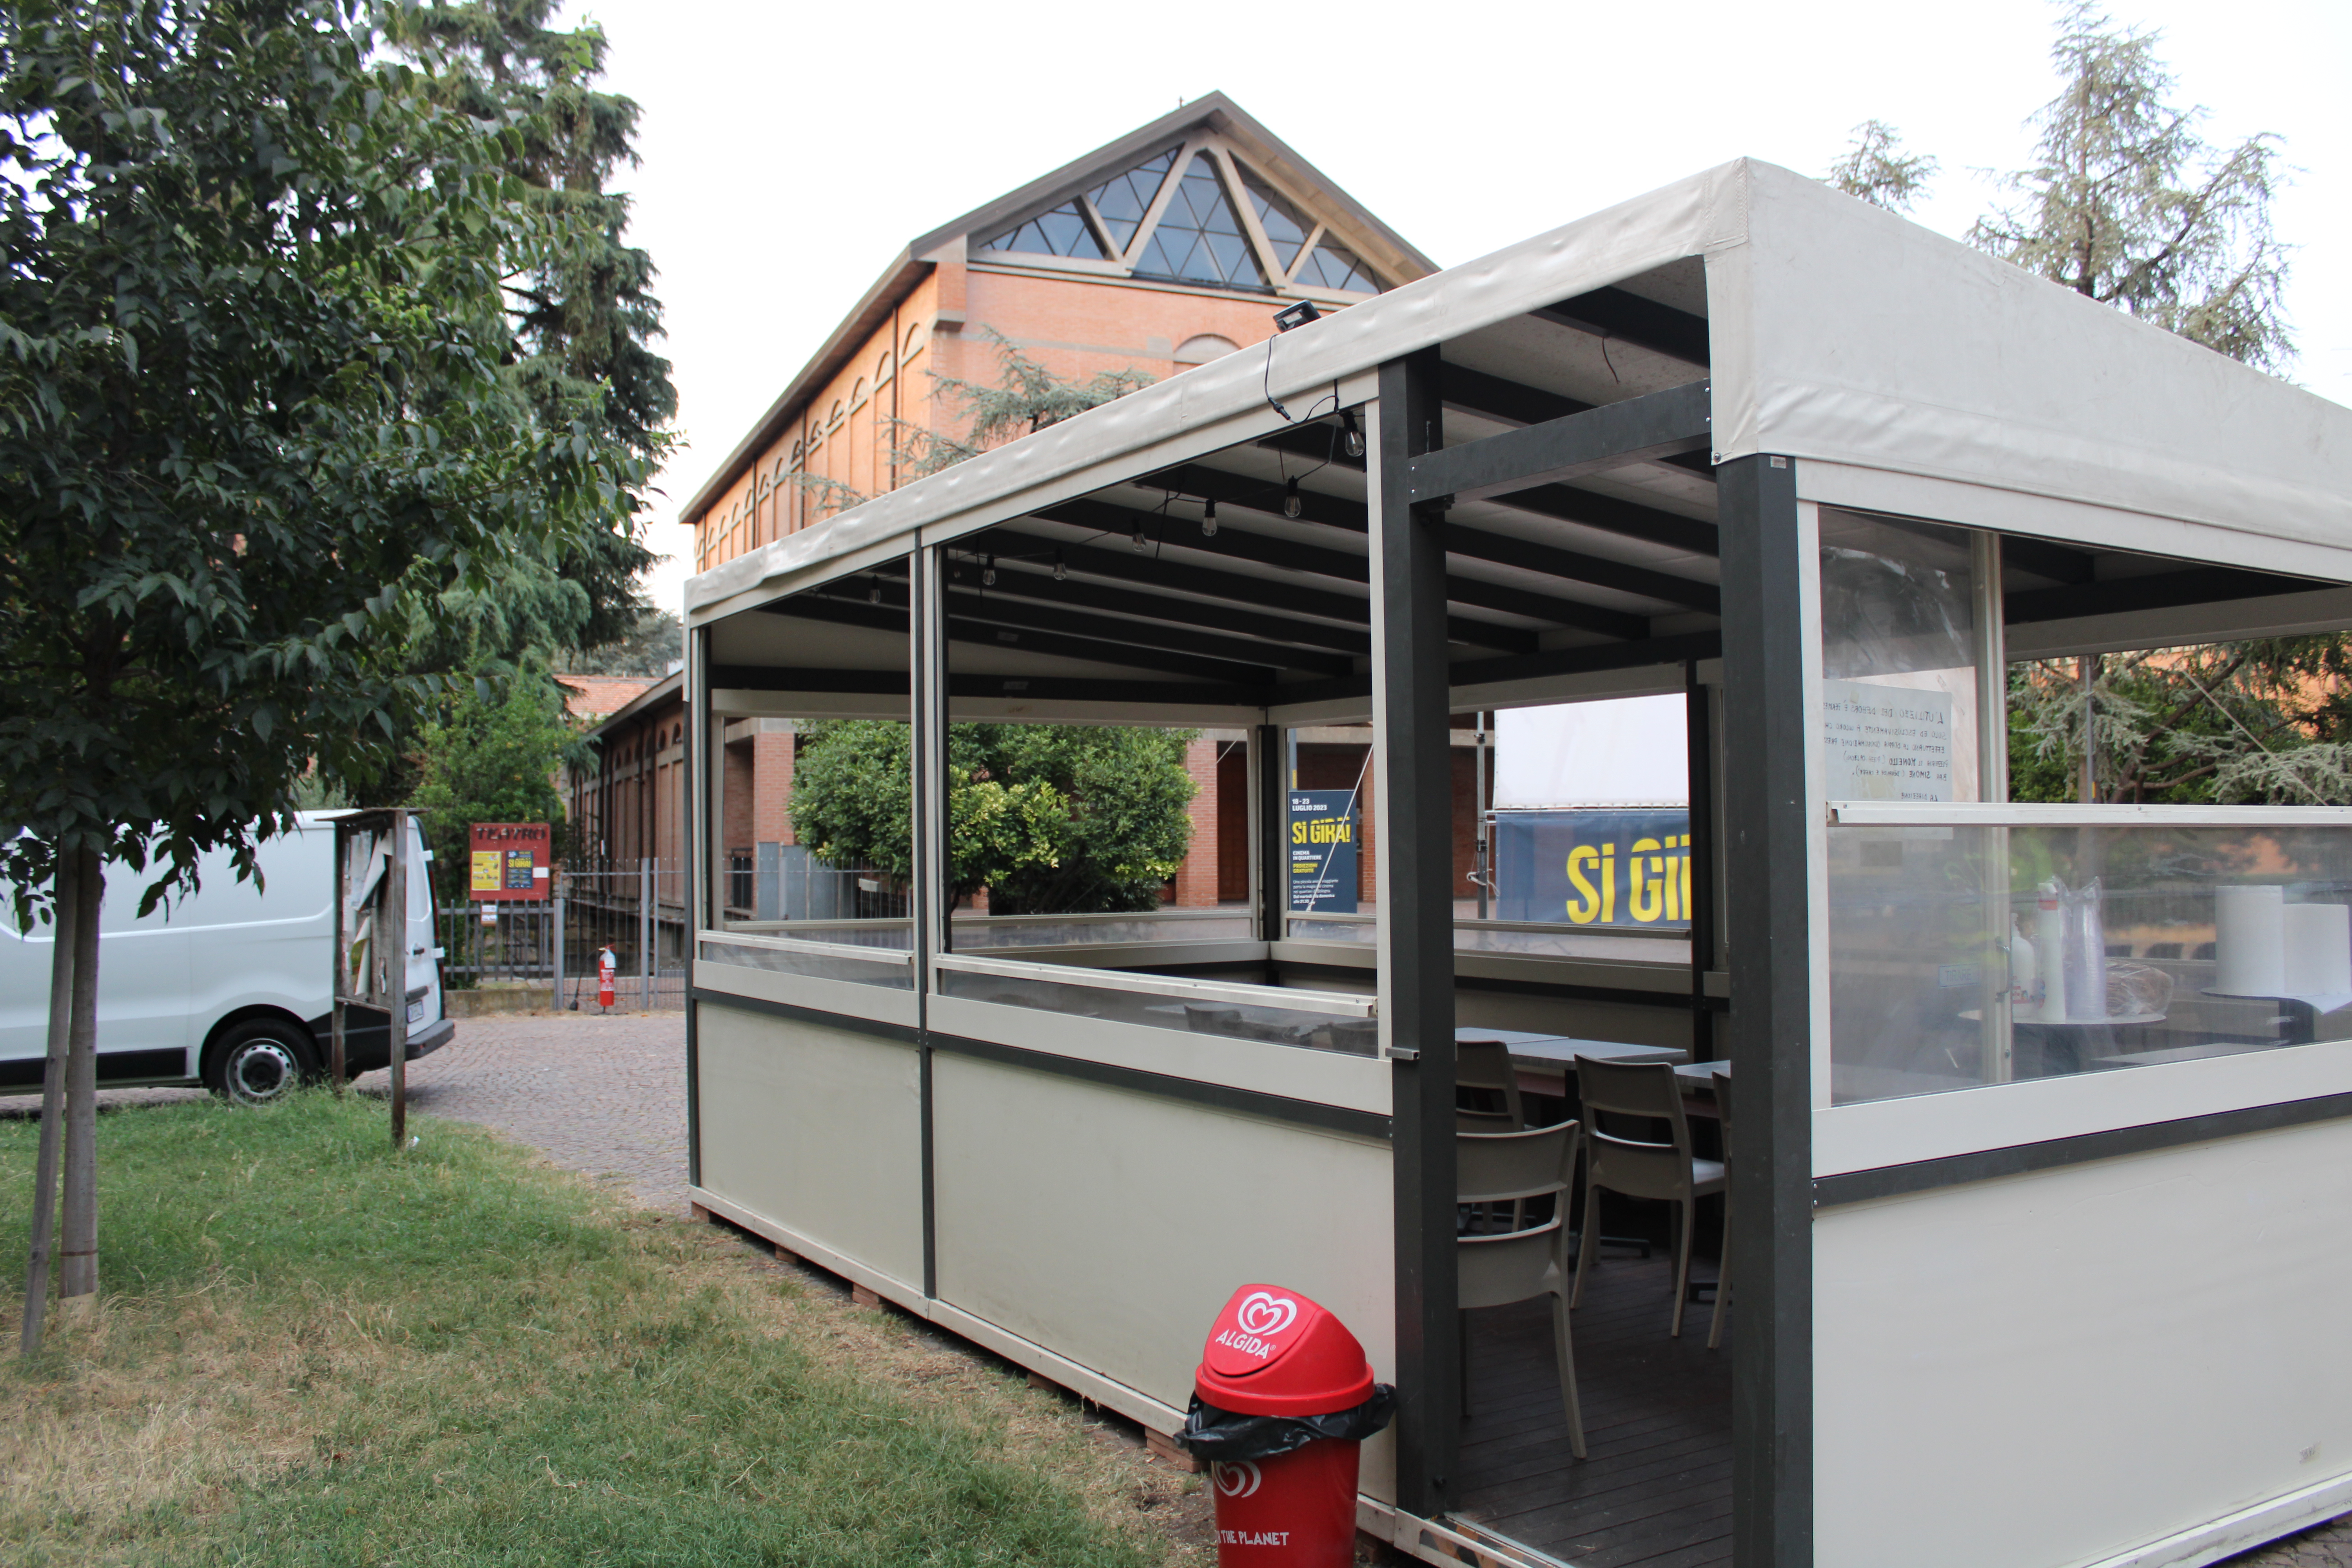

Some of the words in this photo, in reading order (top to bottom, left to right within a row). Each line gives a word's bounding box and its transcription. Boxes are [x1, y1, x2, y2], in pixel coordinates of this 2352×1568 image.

[476, 827, 546, 840] TEATRO
[1292, 821, 1307, 844] SI
[1310, 816, 1351, 844] GIRA!
[1566, 843, 1615, 924] SI
[1628, 833, 1692, 922] GI
[1215, 1328, 1270, 1359] ALGIDA
[1220, 1530, 1237, 1544] THE
[1238, 1530, 1290, 1546] PLANET
